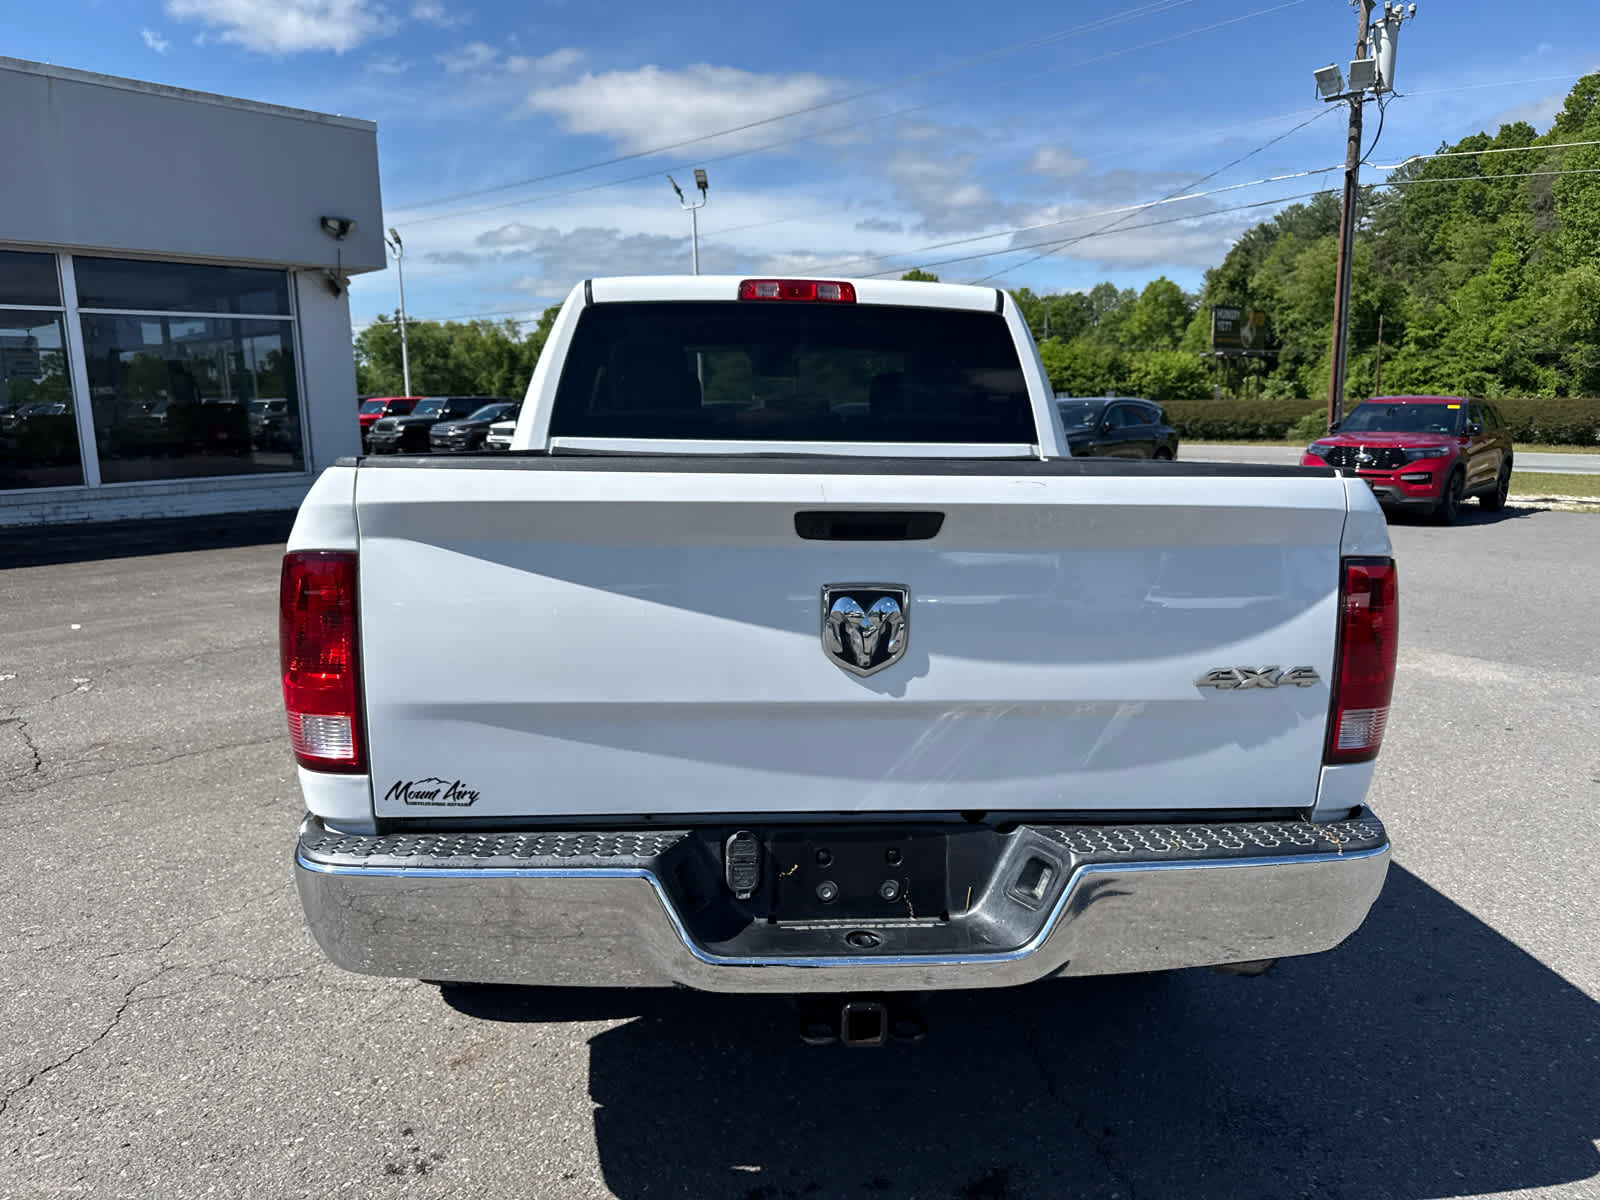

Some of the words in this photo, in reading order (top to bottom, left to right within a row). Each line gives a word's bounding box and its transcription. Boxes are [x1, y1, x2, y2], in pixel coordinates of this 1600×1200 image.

[1194, 666, 1320, 690] 4X4
[384, 780, 441, 804] Mount
[443, 780, 480, 805] Airy
